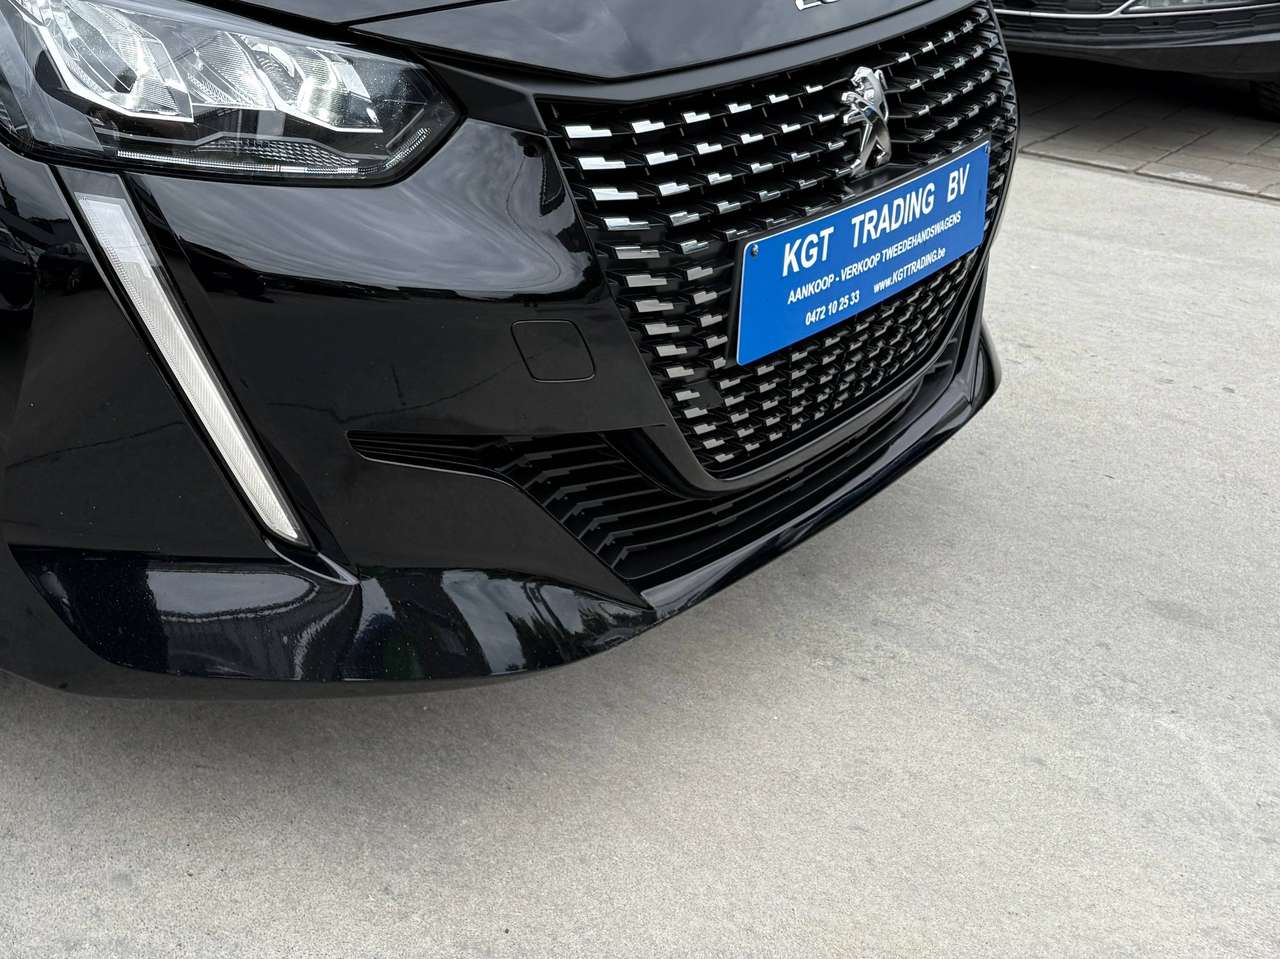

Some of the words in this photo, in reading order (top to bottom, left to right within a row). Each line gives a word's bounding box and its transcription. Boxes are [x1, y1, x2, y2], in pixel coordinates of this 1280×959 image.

[782, 226, 835, 277] KGT
[851, 182, 935, 248] TRADING
[947, 163, 970, 204] BV
[787, 273, 835, 305] AANKOOP
[840, 252, 881, 282] VERKOOP
[881, 210, 962, 262] TWEEDEHANDSWAGENS
[873, 247, 946, 294] www.KGTTRADING.be
[805, 305, 827, 326] 0472
[827, 300, 838, 316] 10
[838, 294, 850, 311] 25
[849, 289, 860, 306] 33
